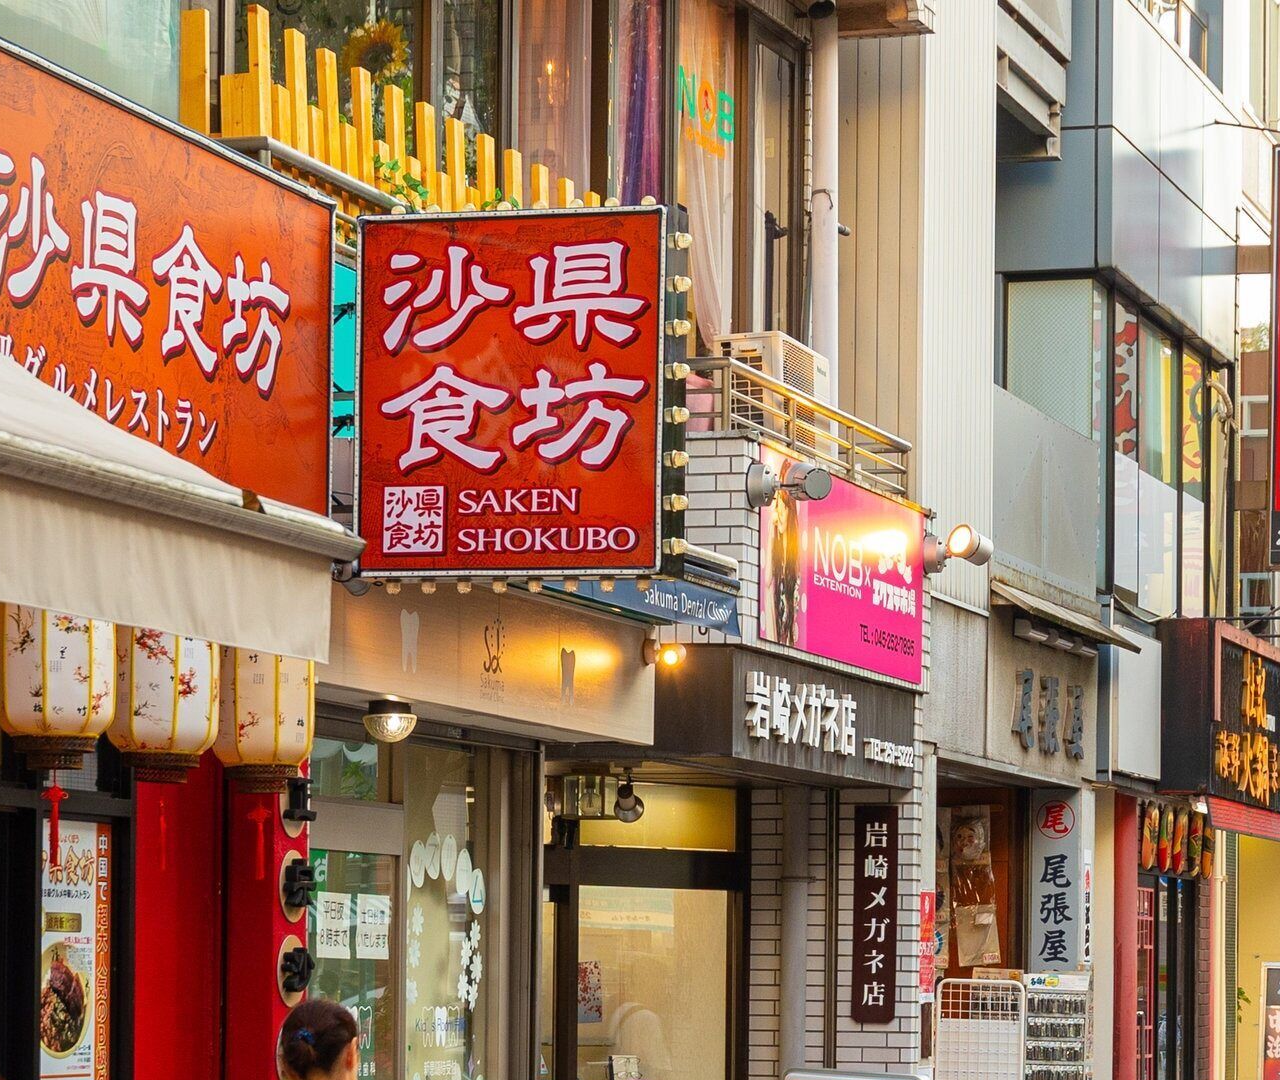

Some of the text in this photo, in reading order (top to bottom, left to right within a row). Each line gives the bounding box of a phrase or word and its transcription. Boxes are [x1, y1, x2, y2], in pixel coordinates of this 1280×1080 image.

[382, 241, 649, 352] 沙県
[381, 362, 649, 472] 食坊
[386, 489, 442, 518] 沙県
[458, 488, 578, 514] SAKEN
[385, 521, 442, 550] 食坊
[457, 526, 637, 551] SHOKUBO
[814, 527, 864, 588] NOB
[813, 573, 862, 600] EXTENTION
[681, 593, 705, 619] Dental
[746, 671, 858, 757] 岩崎メガネ店
[1040, 802, 1069, 834] 尾
[862, 820, 891, 1007] 岩崎メガネ店
[1038, 853, 1073, 963] 尾張屋
[320, 929, 348, 947] 8時まで
